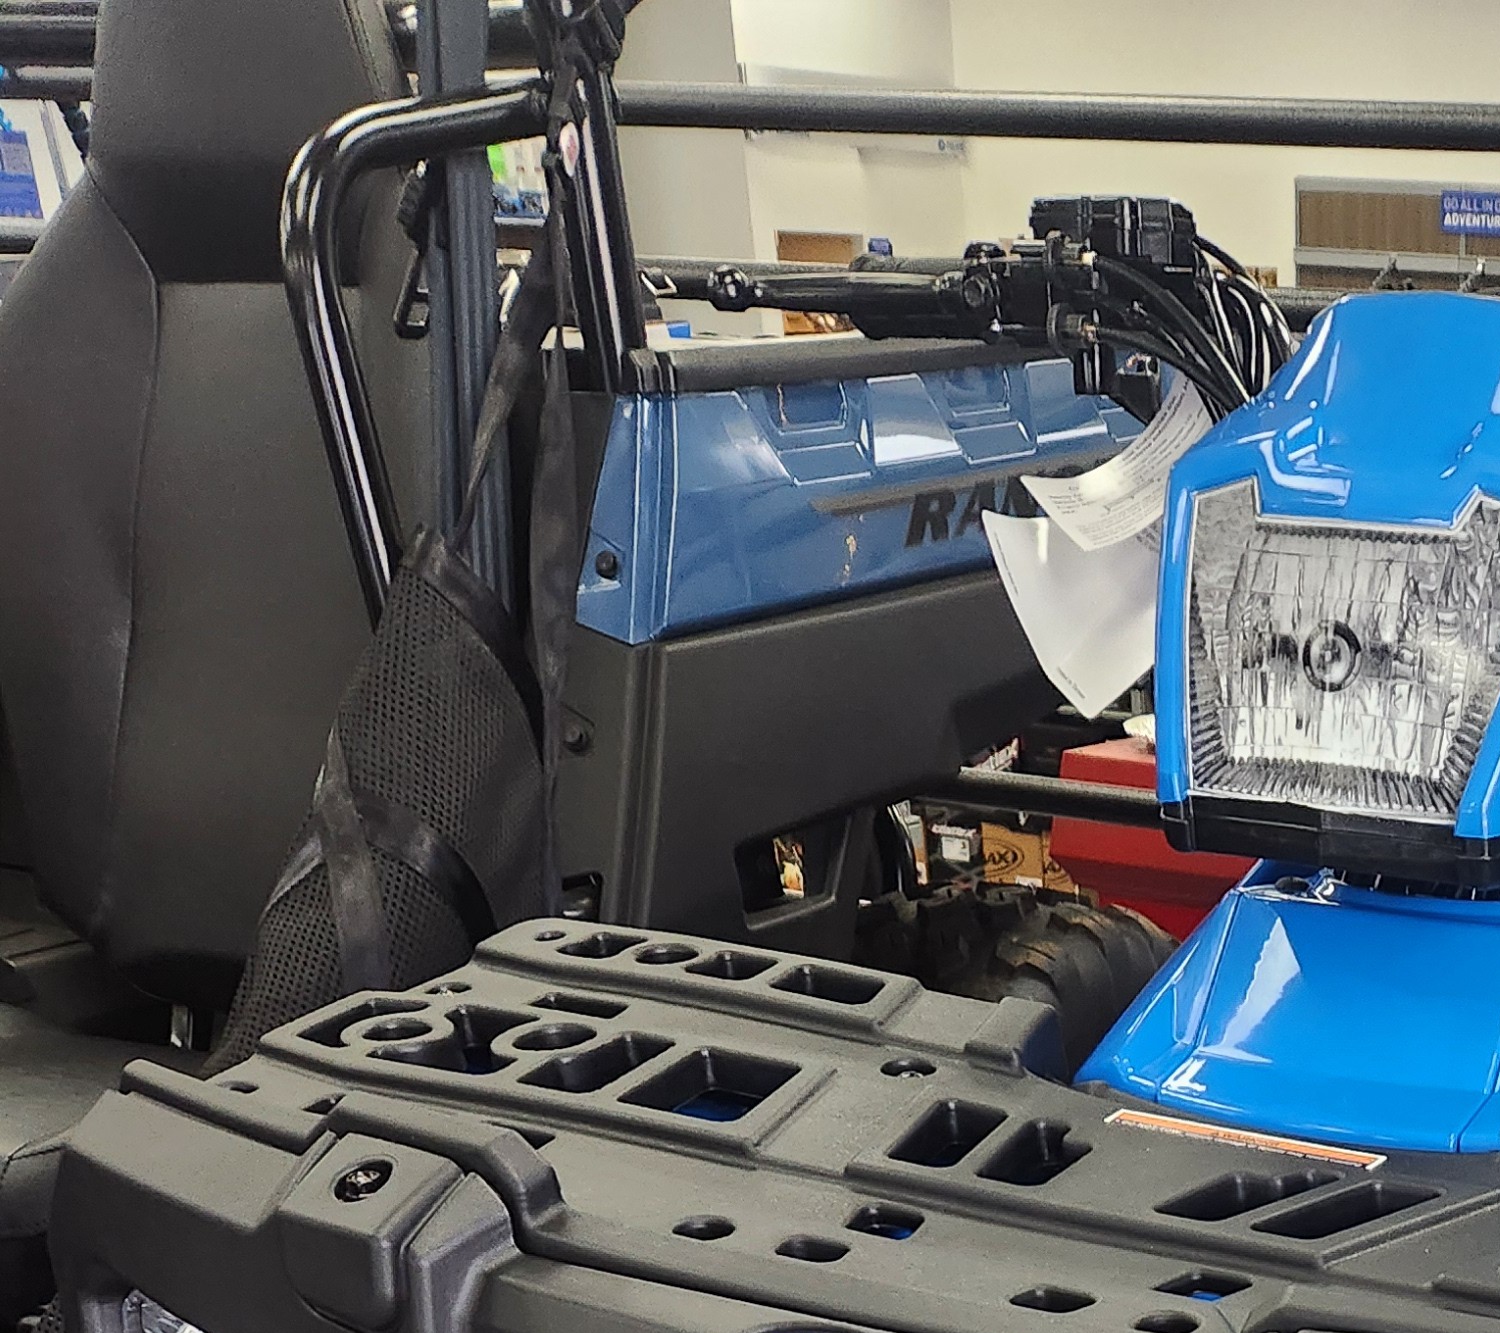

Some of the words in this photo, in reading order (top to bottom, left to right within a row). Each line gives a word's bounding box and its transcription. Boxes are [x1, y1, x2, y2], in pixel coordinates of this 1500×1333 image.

[1444, 197, 1459, 210] GO
[1460, 198, 1479, 212] ALL
[1481, 199, 1494, 212] IN
[904, 474, 1040, 548] RAN
